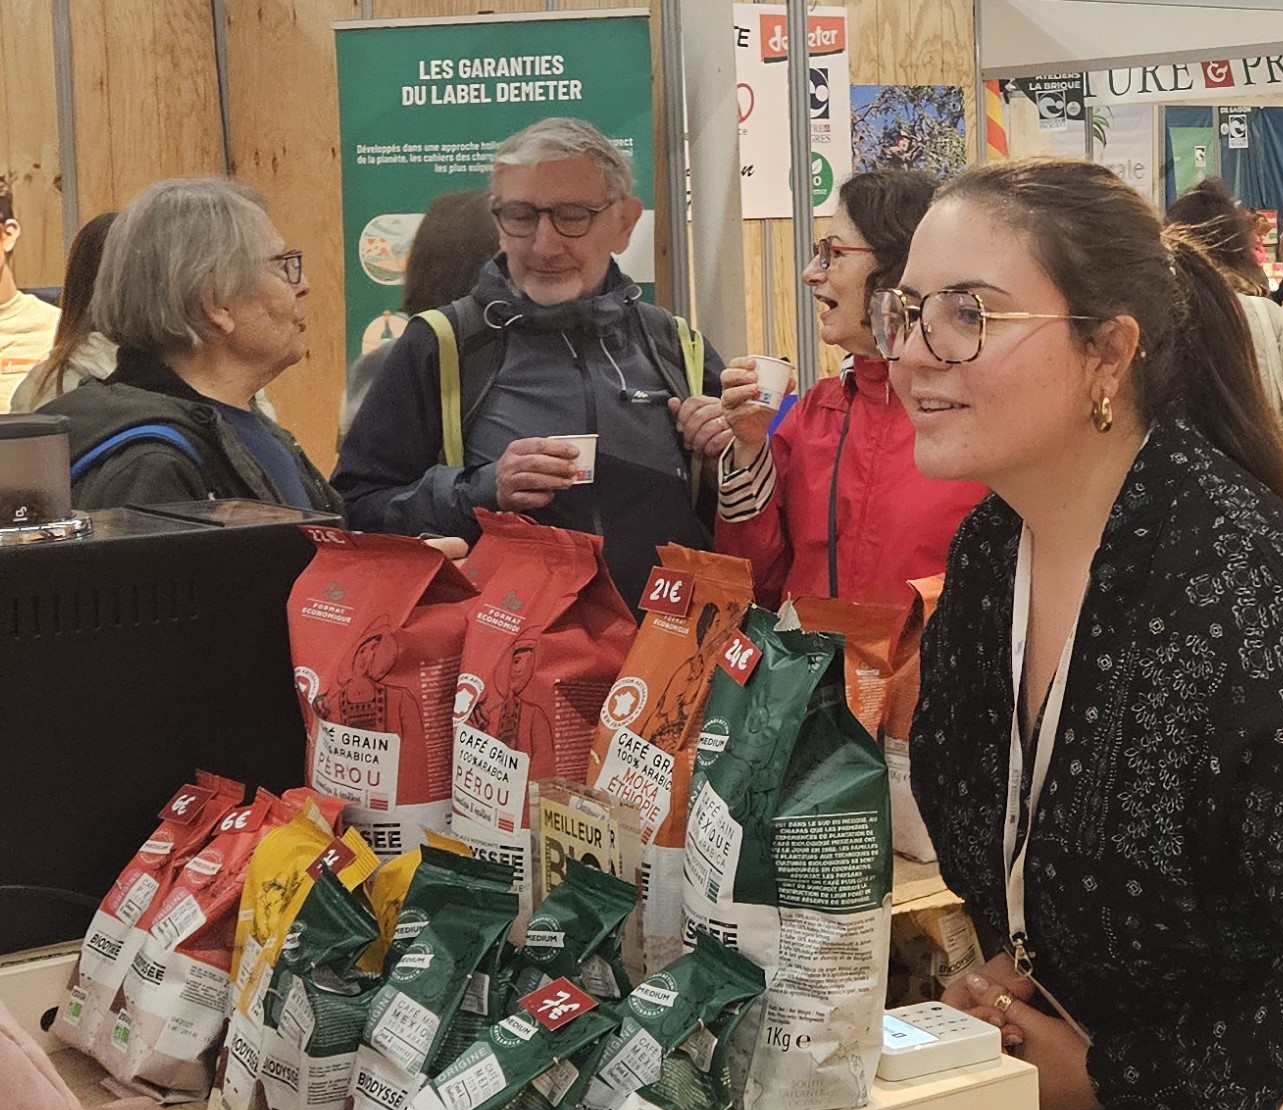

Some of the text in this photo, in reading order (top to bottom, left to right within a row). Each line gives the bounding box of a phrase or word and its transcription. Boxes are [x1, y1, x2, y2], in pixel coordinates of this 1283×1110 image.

[769, 25, 838, 53] deeter
[419, 55, 564, 80] LES GARANTIES
[1206, 61, 1228, 83] &
[402, 80, 582, 106] DU LABEL DEMETER
[1029, 80, 1081, 91] LA BRIQUE
[402, 143, 423, 153] dans
[424, 143, 439, 152] une
[441, 141, 479, 153] approche
[455, 152, 470, 162] des
[649, 578, 682, 603] 21€
[313, 603, 345, 614] FORMAT
[488, 608, 522, 625] FORMAT
[342, 733, 388, 751] GRAIN
[460, 731, 488, 754] CAFÉ
[617, 732, 674, 776] CAFÉ GRA
[319, 752, 380, 787] PÉROU
[616, 748, 673, 793] 100% ARABIC
[457, 766, 509, 806] PÉROU
[622, 767, 659, 802] MOKA
[608, 773, 661, 826] ÉTHIOPIE
[220, 810, 252, 831] 6€
[543, 809, 602, 849] MEILLEUR
[527, 934, 557, 944] MEDIUM
[637, 986, 670, 1001] MEDIUM
[766, 1027, 791, 1051] 1Kg
